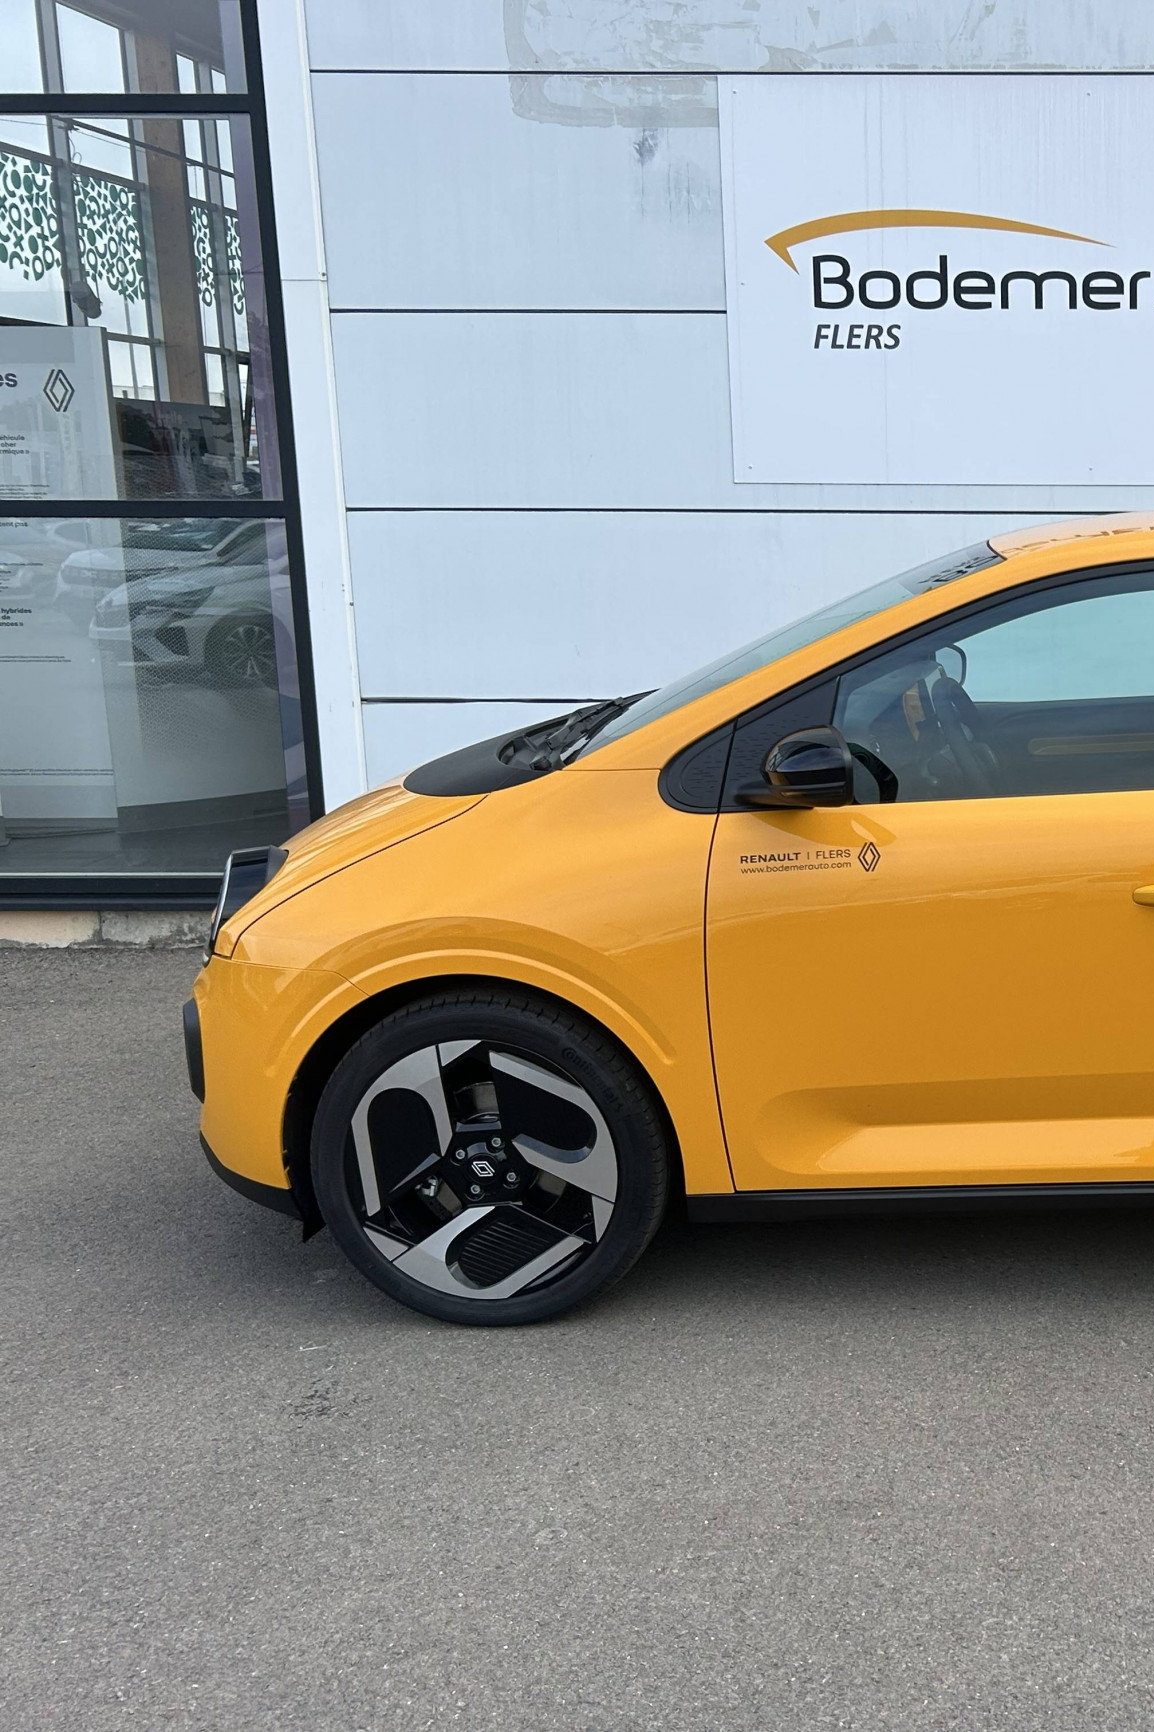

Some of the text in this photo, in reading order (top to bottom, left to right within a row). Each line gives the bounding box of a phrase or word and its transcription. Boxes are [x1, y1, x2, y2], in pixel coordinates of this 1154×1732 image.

[813, 324, 900, 350] FLERS
[740, 852, 802, 864] RENAULT
[815, 849, 852, 860] FLERS
[740, 862, 852, 874] www.bodemerauto.com
[562, 1047, 619, 1103] Continental
